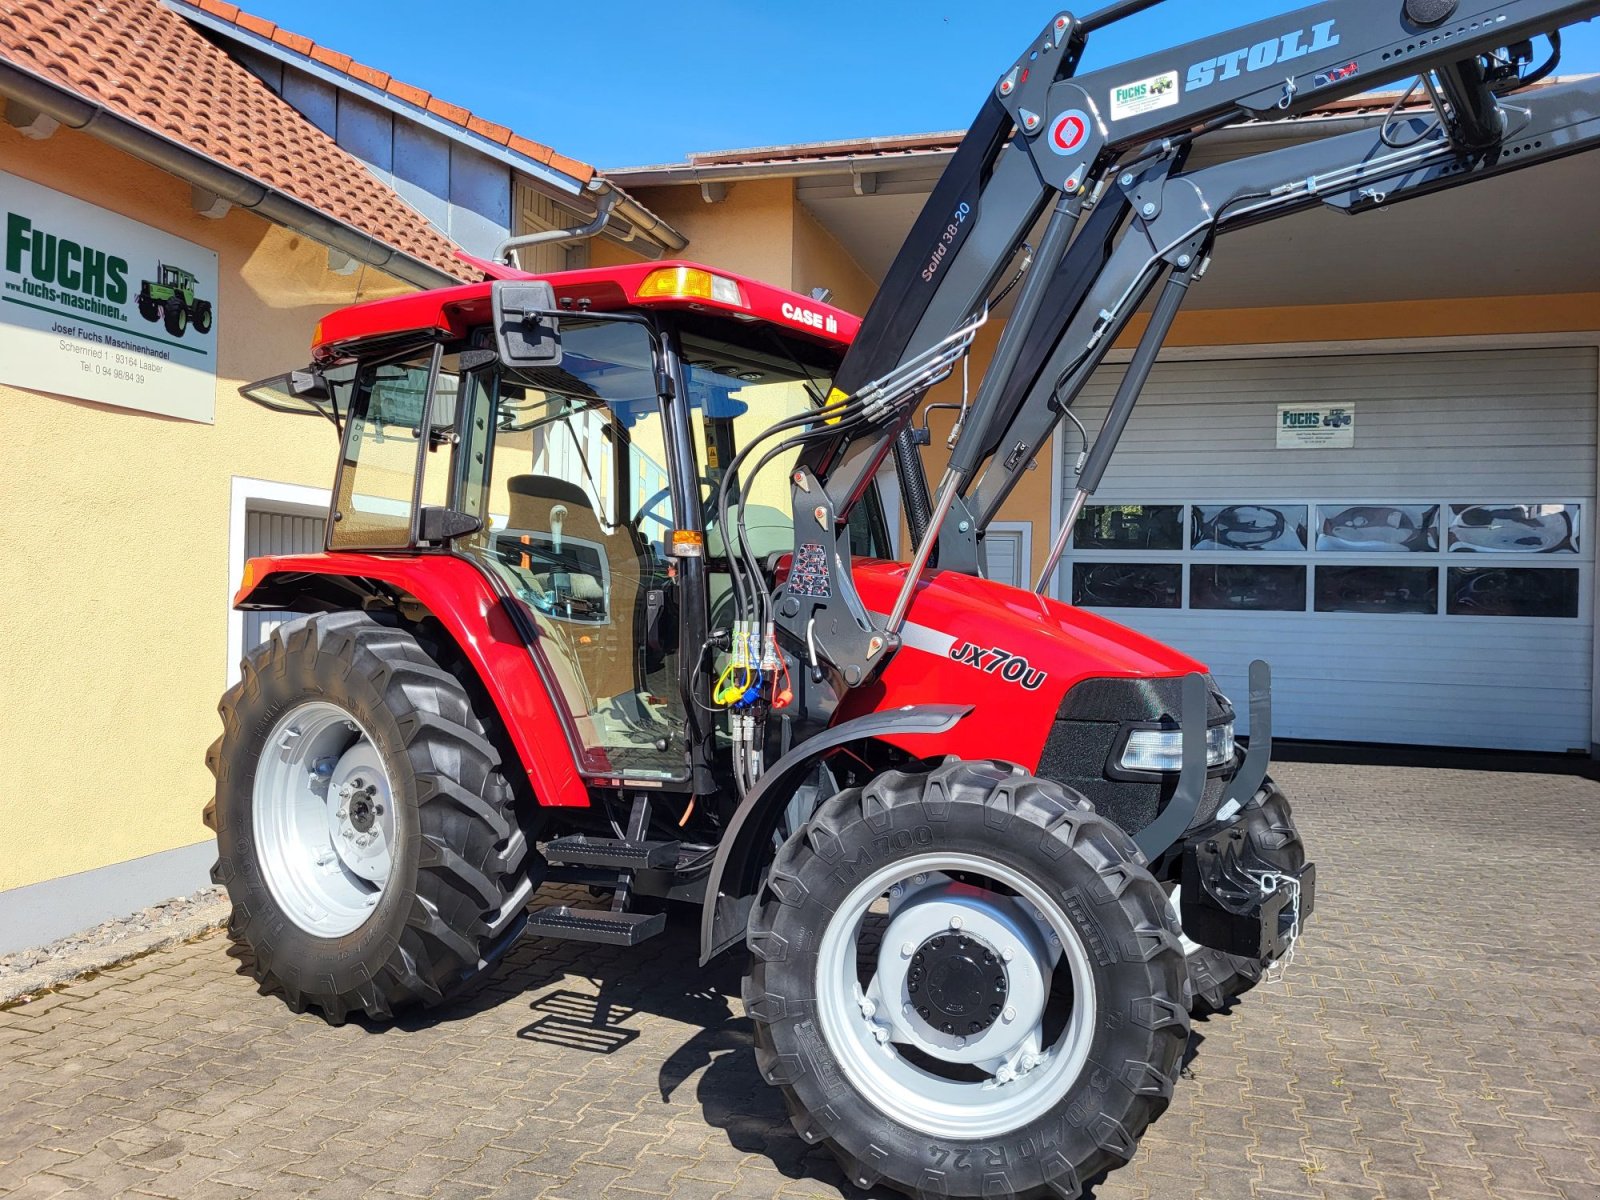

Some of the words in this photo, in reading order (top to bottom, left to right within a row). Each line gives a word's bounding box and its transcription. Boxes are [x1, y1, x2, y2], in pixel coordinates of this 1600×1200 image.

[1185, 18, 1340, 92] STOLL
[1116, 83, 1147, 102] FUCHS
[6, 211, 129, 305] FUCHS
[921, 242, 947, 283] Solid
[942, 201, 970, 244] 38-20
[5, 277, 128, 322] www.fuchs-maschinen.de
[781, 302, 823, 329] CASE
[51, 321, 76, 335] Josef
[78, 328, 103, 344] Fuchs
[104, 334, 170, 361] Maschinenhandel
[115, 353, 138, 367] 93164
[139, 359, 164, 373] Laaber
[80, 360, 94, 372] Tel.
[95, 364, 101, 375] 0
[102, 366, 112, 377] 94
[135, 373, 145, 385] 39
[1282, 410, 1320, 425] FUCHS
[950, 641, 1048, 691] JX70U
[826, 845, 874, 889] TM
[871, 824, 934, 858] 700
[1060, 884, 1117, 968] PIRELLI
